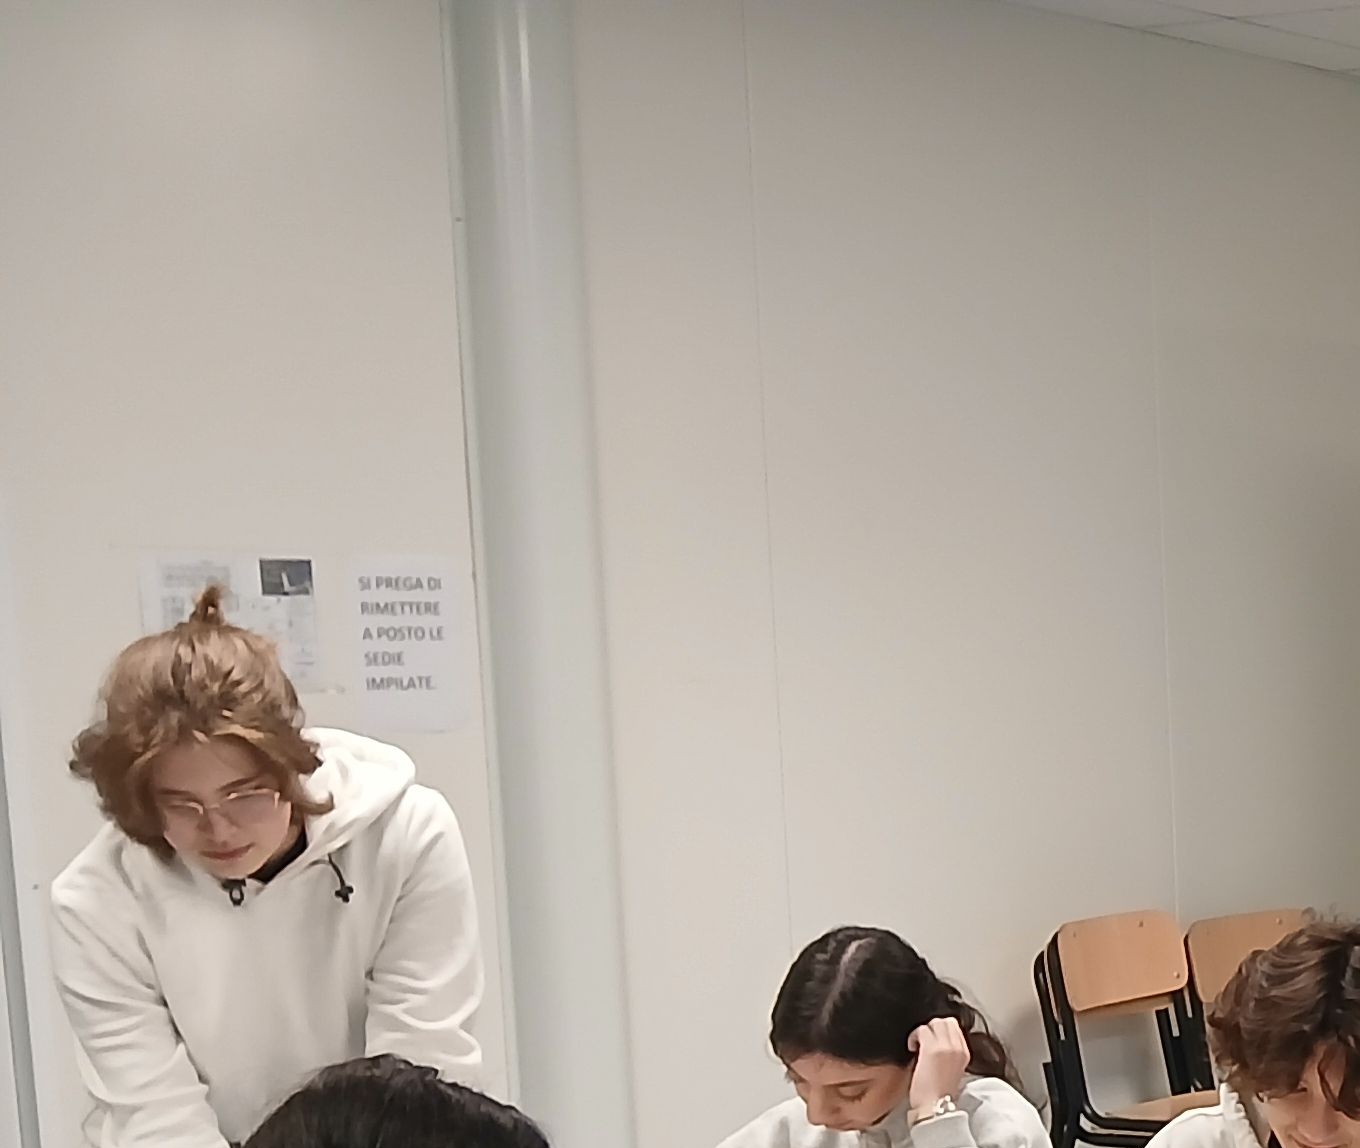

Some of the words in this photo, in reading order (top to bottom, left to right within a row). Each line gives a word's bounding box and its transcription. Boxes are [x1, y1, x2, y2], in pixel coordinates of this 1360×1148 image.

[358, 576, 371, 591] SI
[375, 576, 424, 591] PREGA
[427, 577, 442, 591] DI
[360, 601, 440, 616] RIMETTERE
[362, 626, 374, 640] A
[376, 626, 426, 641] POSTO
[429, 626, 444, 641] LE
[364, 651, 405, 666] SEDIE
